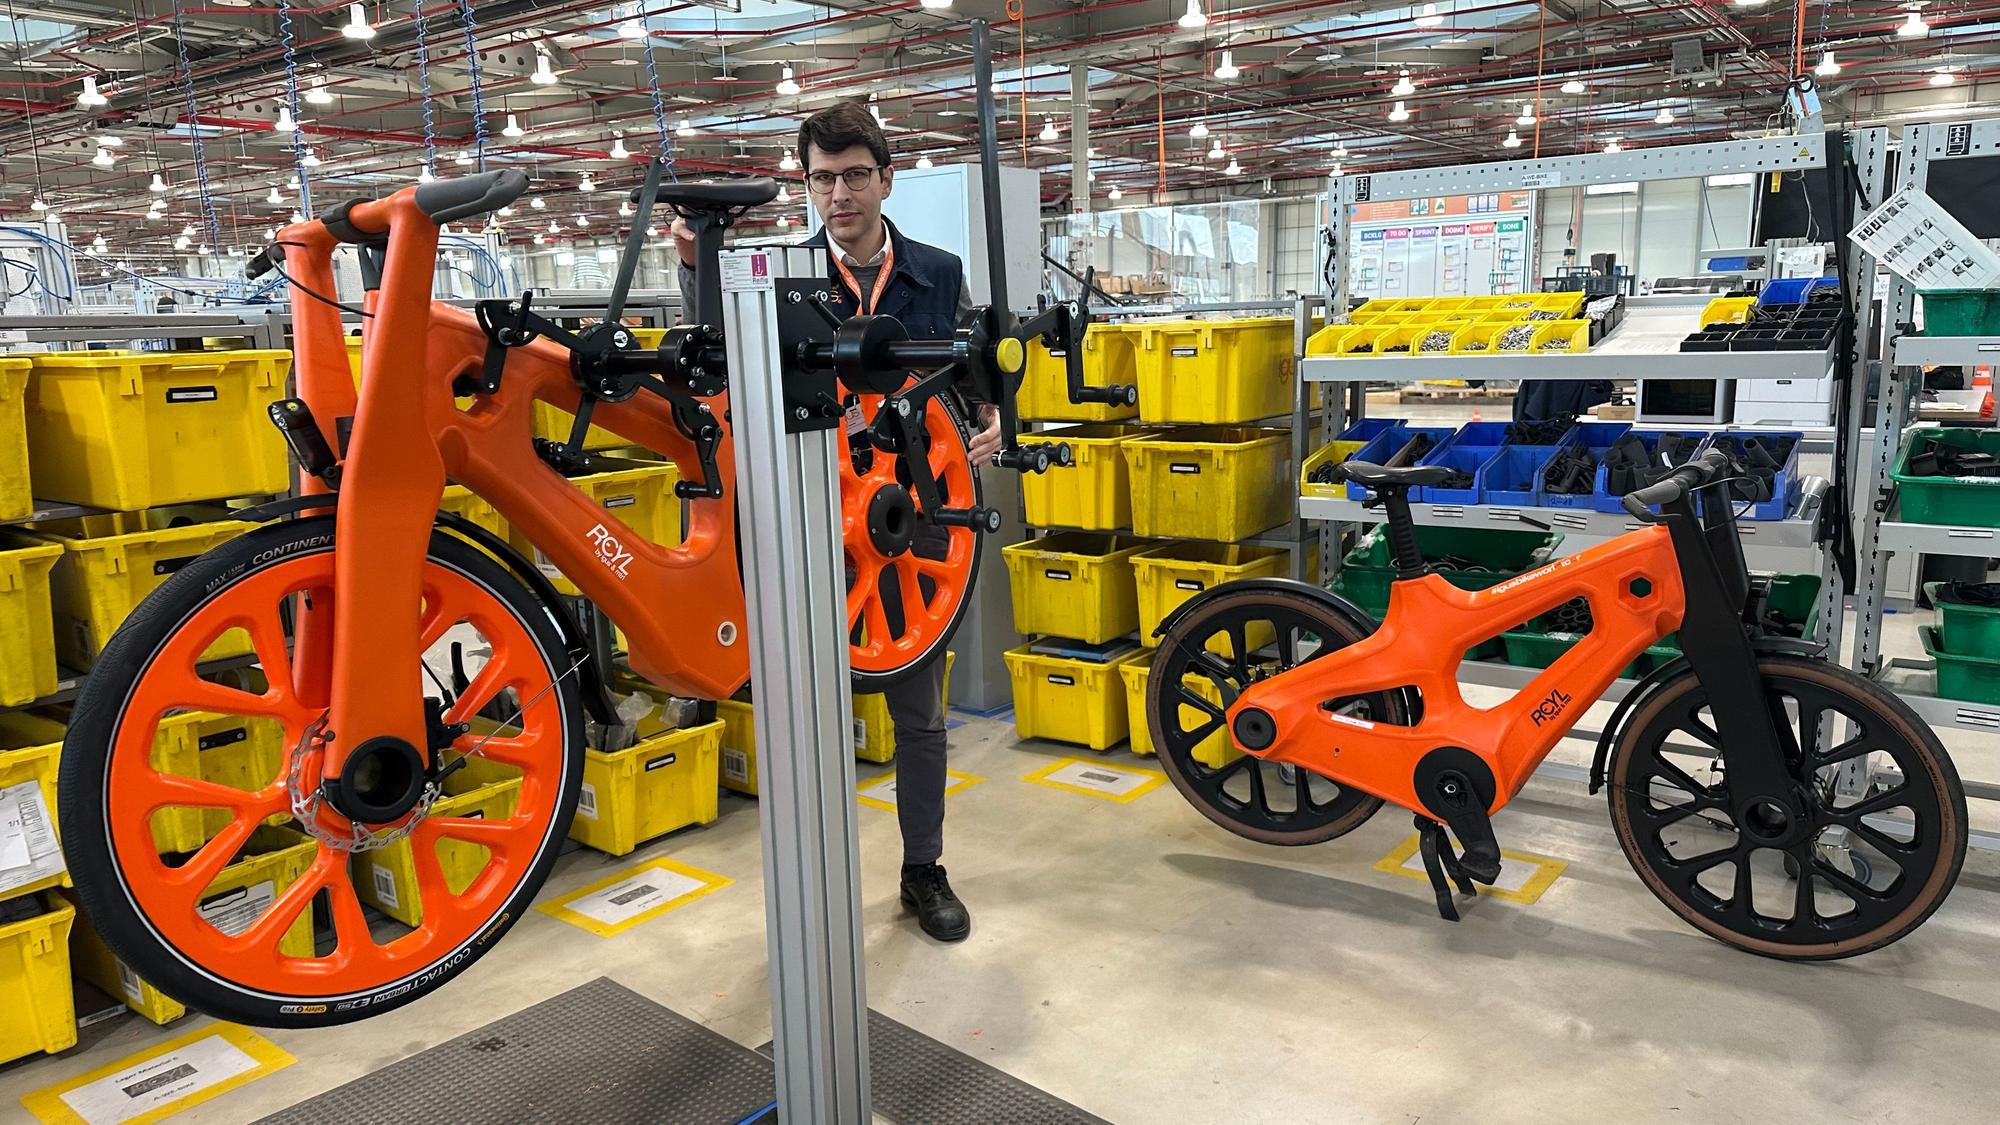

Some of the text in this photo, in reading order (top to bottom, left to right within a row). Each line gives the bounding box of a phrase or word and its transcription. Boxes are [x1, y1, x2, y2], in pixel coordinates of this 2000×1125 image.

[1445, 226, 1464, 234] DOING
[1502, 222, 1520, 230] DONE
[585, 523, 635, 576] RCYL
[205, 572, 228, 593] MAX
[1530, 688, 1570, 728] RCYL
[411, 947, 471, 991] CONTACT
